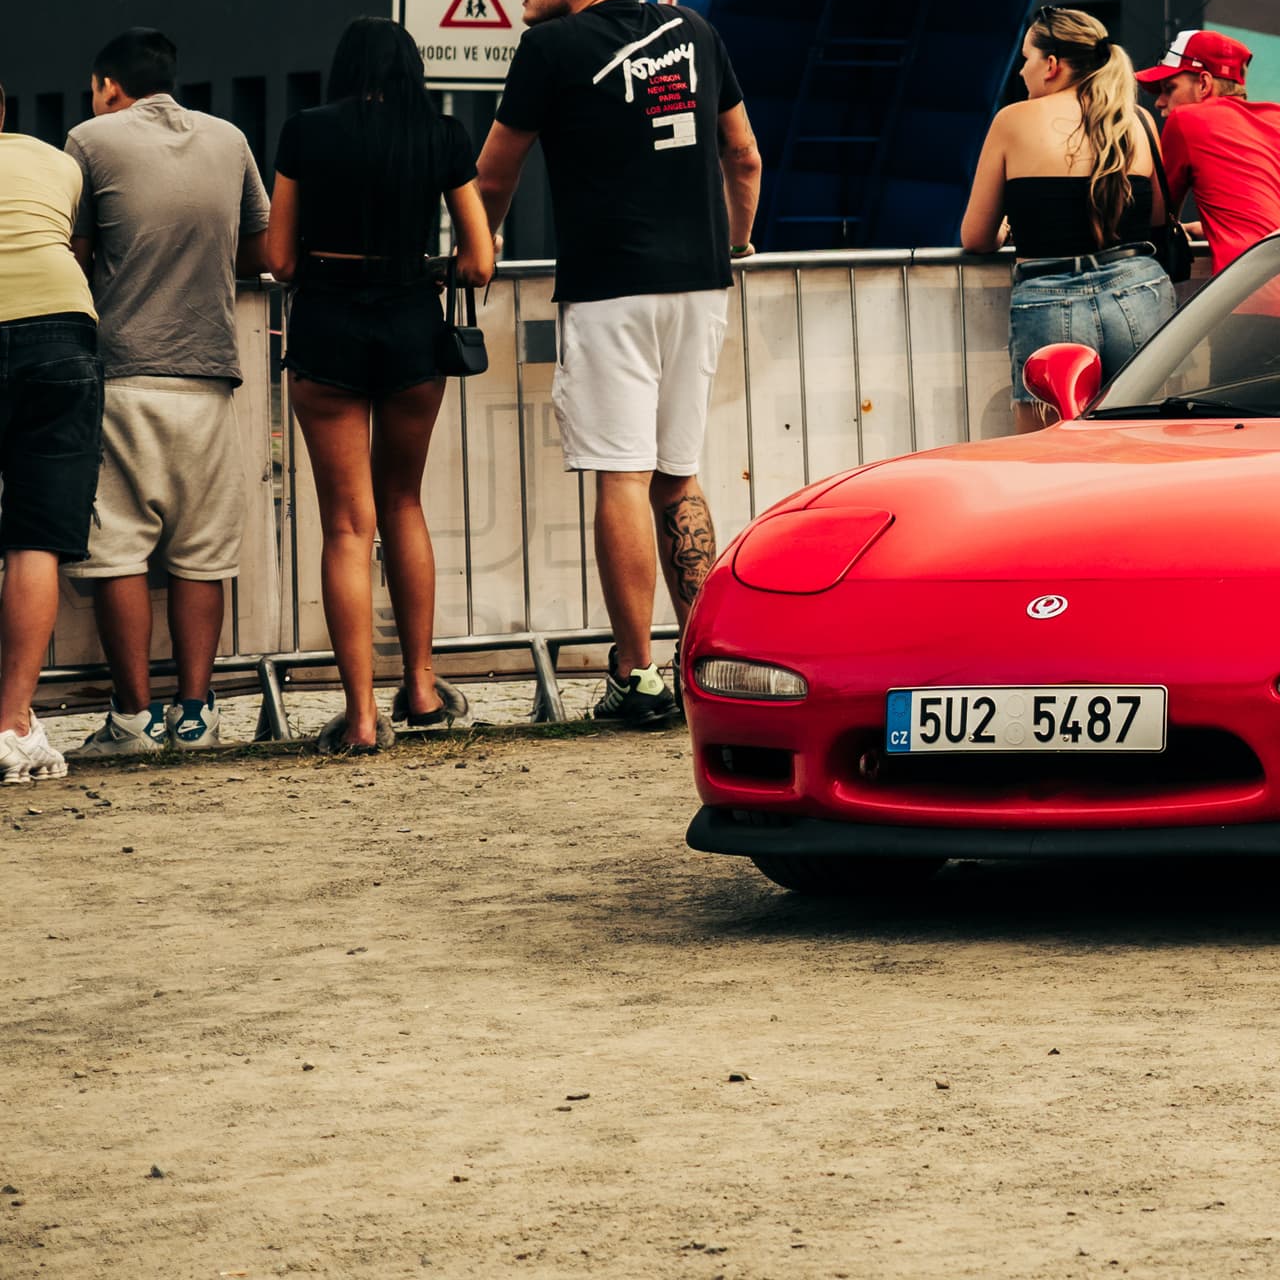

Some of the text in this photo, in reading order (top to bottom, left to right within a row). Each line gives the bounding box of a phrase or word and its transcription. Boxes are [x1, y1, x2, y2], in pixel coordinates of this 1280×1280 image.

[418, 45, 517, 61] HODCI VE VOZO
[593, 17, 698, 103] Tommy
[649, 73, 681, 85] LONDON
[647, 82, 688, 95] NEW YORK
[659, 93, 681, 102] PARIS
[645, 100, 697, 115] LOS ANGELES
[890, 695, 1141, 745] CZ 5U2 5487
